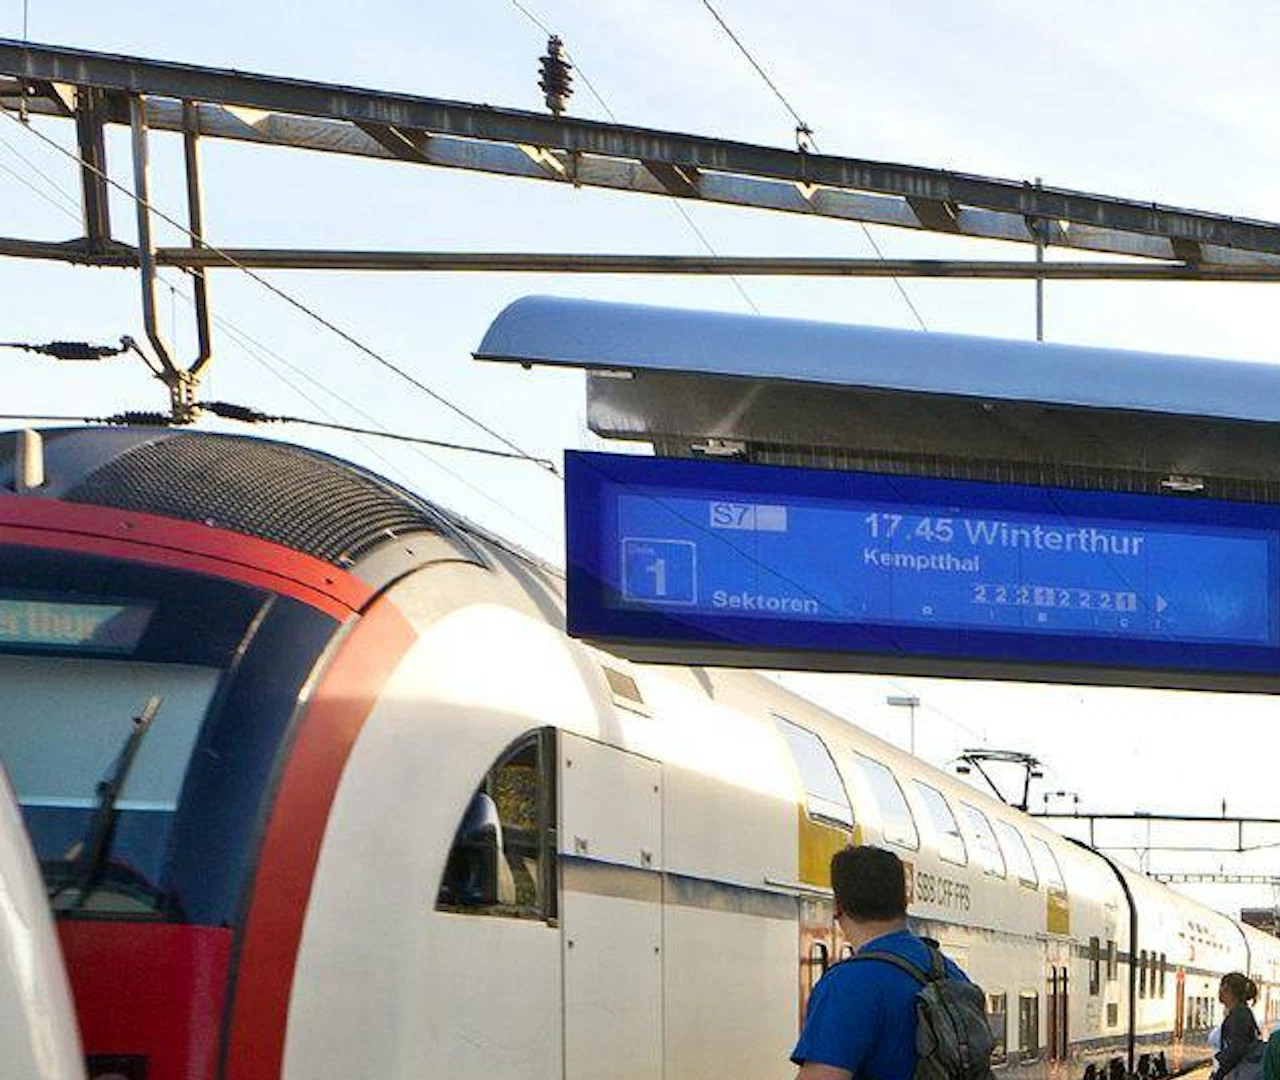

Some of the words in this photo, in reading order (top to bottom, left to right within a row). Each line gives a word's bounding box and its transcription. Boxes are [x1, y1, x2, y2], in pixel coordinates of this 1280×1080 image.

[713, 504, 749, 527] S7
[864, 512, 954, 542] 17.45
[963, 519, 1144, 555] Winterthur
[863, 548, 980, 573] Kemptthal
[646, 557, 667, 596] 1
[711, 589, 820, 613] Sektoren
[917, 871, 936, 903] SBB
